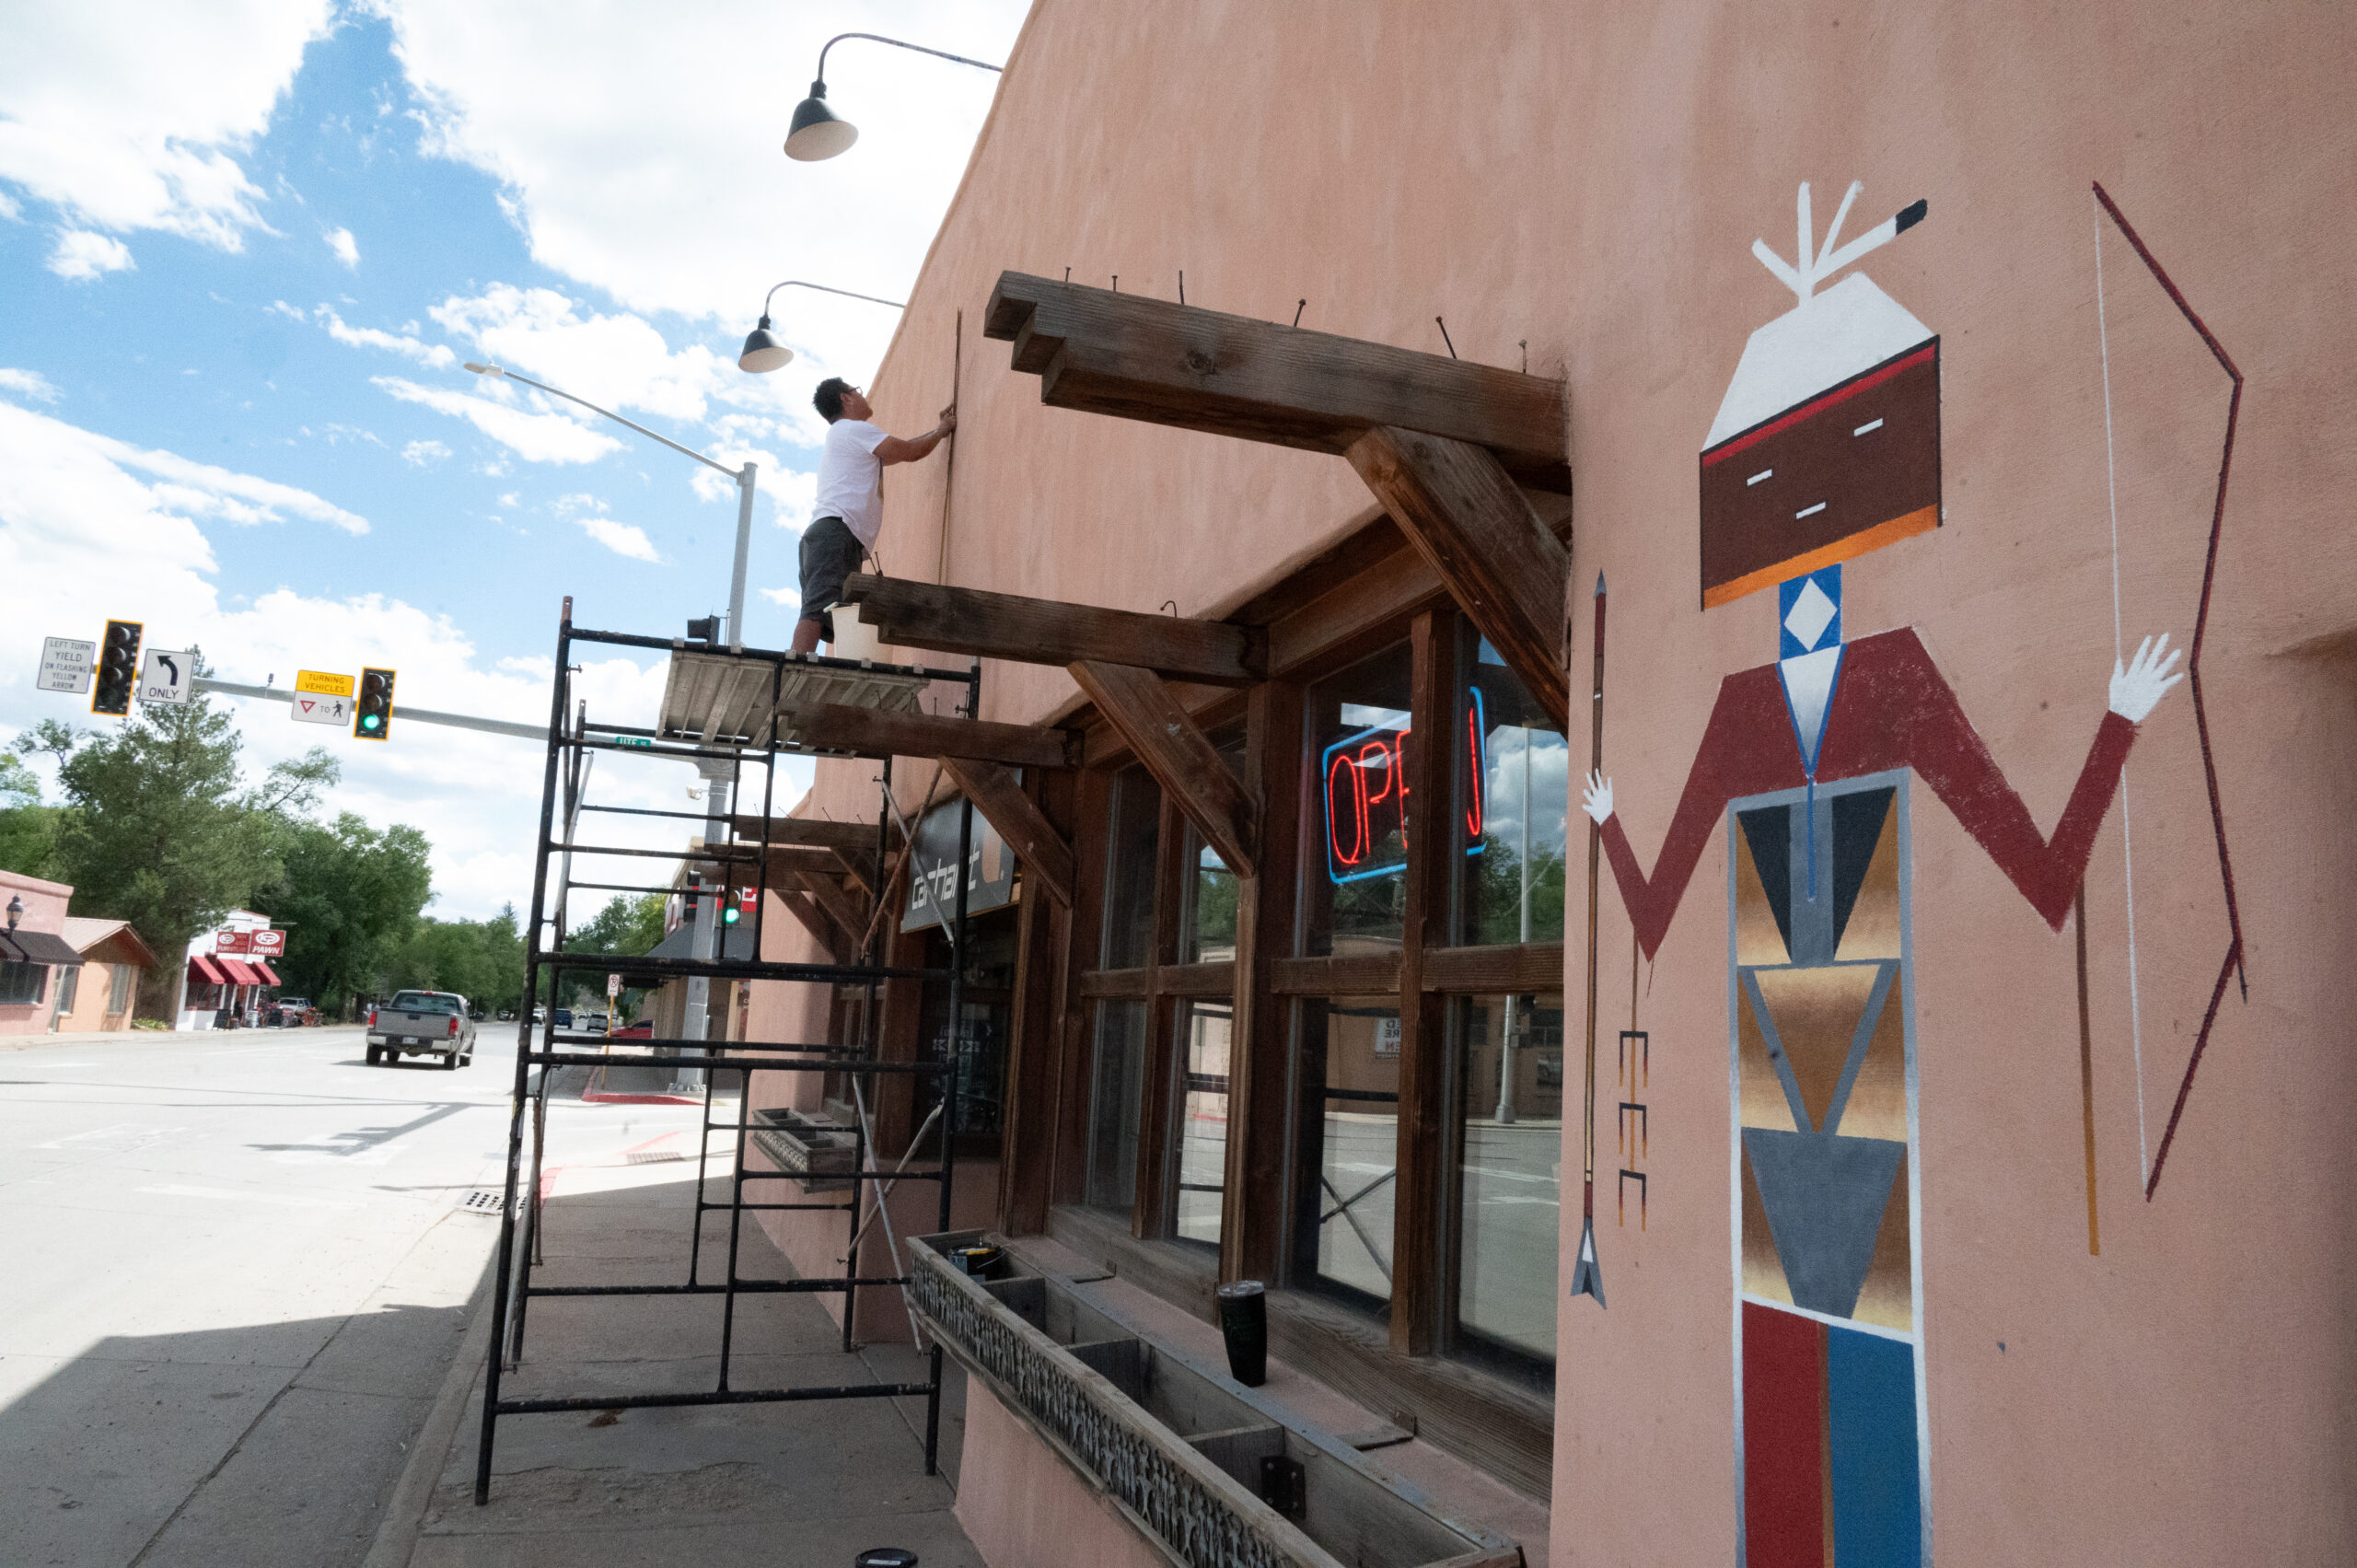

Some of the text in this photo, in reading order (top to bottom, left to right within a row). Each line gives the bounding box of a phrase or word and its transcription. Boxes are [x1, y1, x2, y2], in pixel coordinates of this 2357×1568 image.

[49, 640, 91, 651] LEFT TURN
[55, 652, 83, 662] YIELD
[56, 663, 87, 673] FLASHING
[52, 672, 77, 680] YELLOW
[308, 674, 345, 684] TURNING
[305, 682, 345, 692] VEHICLES
[148, 687, 180, 700] ONLY
[320, 705, 331, 714] TO
[1329, 707, 1480, 865] OPE
[252, 946, 279, 954] PAWN
